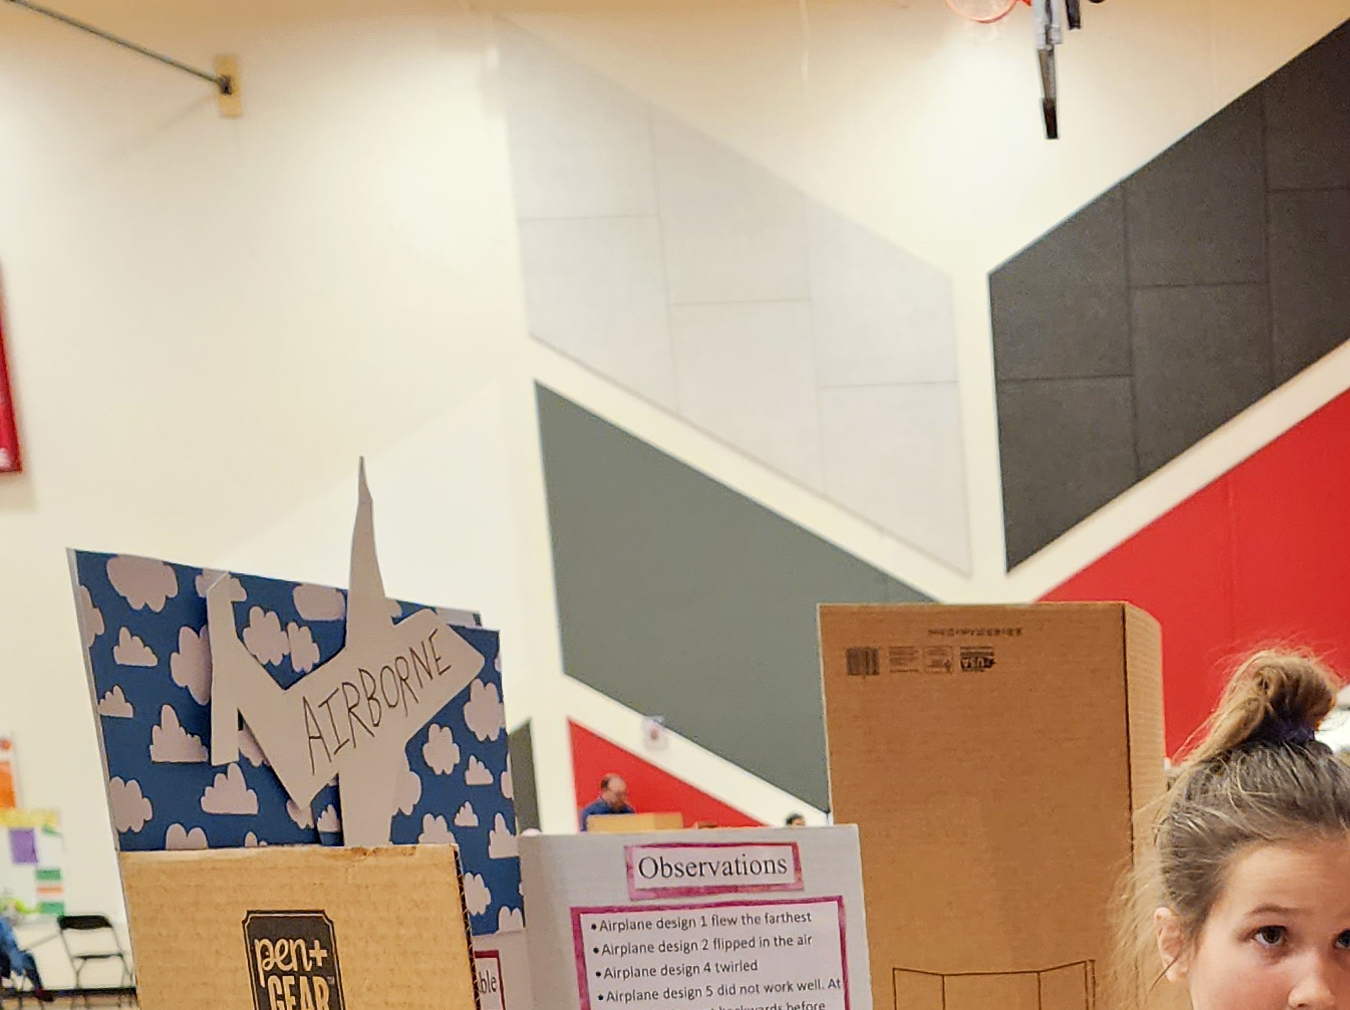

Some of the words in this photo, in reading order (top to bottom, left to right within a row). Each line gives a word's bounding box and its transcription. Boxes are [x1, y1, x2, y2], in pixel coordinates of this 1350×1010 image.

[301, 628, 452, 776] AIRBORNE
[638, 853, 787, 879] Observations
[599, 918, 652, 933] Airplane
[656, 917, 696, 931] design
[701, 915, 707, 927] 1
[711, 914, 738, 926] flew
[741, 913, 761, 926] the
[764, 912, 812, 924] farthest
[601, 942, 655, 958] Airplane
[658, 940, 698, 954] design
[702, 938, 709, 951] 2
[713, 936, 755, 952] flipped
[759, 936, 770, 948] in
[773, 935, 793, 947] the
[797, 934, 812, 946] air
[254, 938, 328, 988] pen+
[603, 966, 656, 981] Airplane
[660, 963, 700, 977] design
[703, 962, 711, 973] 4
[715, 959, 758, 973] twirled
[606, 989, 659, 1004] Airplane
[663, 987, 702, 1001] design
[706, 985, 713, 997] 5
[717, 984, 736, 996] did
[740, 984, 760, 995] not
[763, 981, 794, 993] work
[796, 979, 824, 991] well.
[828, 978, 841, 989] At
